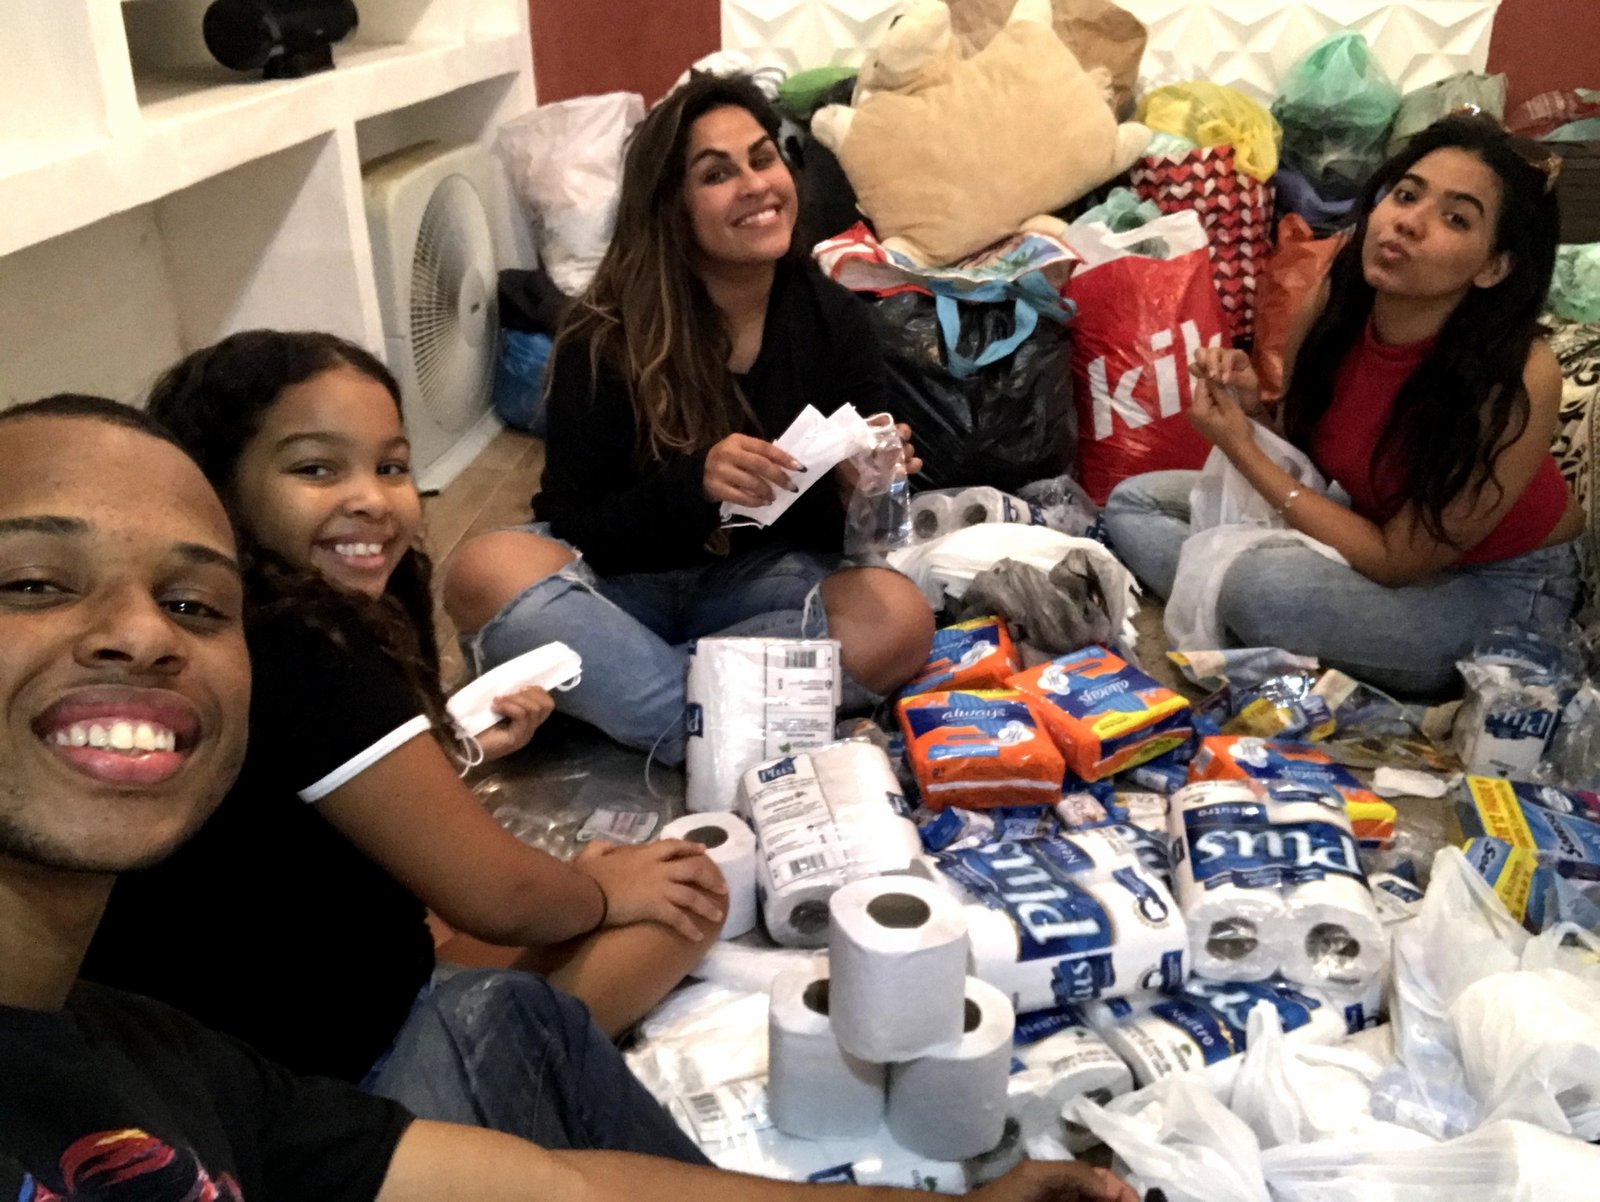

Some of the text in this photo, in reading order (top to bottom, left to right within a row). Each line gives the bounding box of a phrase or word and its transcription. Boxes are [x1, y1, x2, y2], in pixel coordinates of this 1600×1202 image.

[1077, 679, 1130, 707] always
[942, 707, 1006, 719] always
[761, 764, 796, 781] Plus
[1196, 829, 1361, 877] Plus
